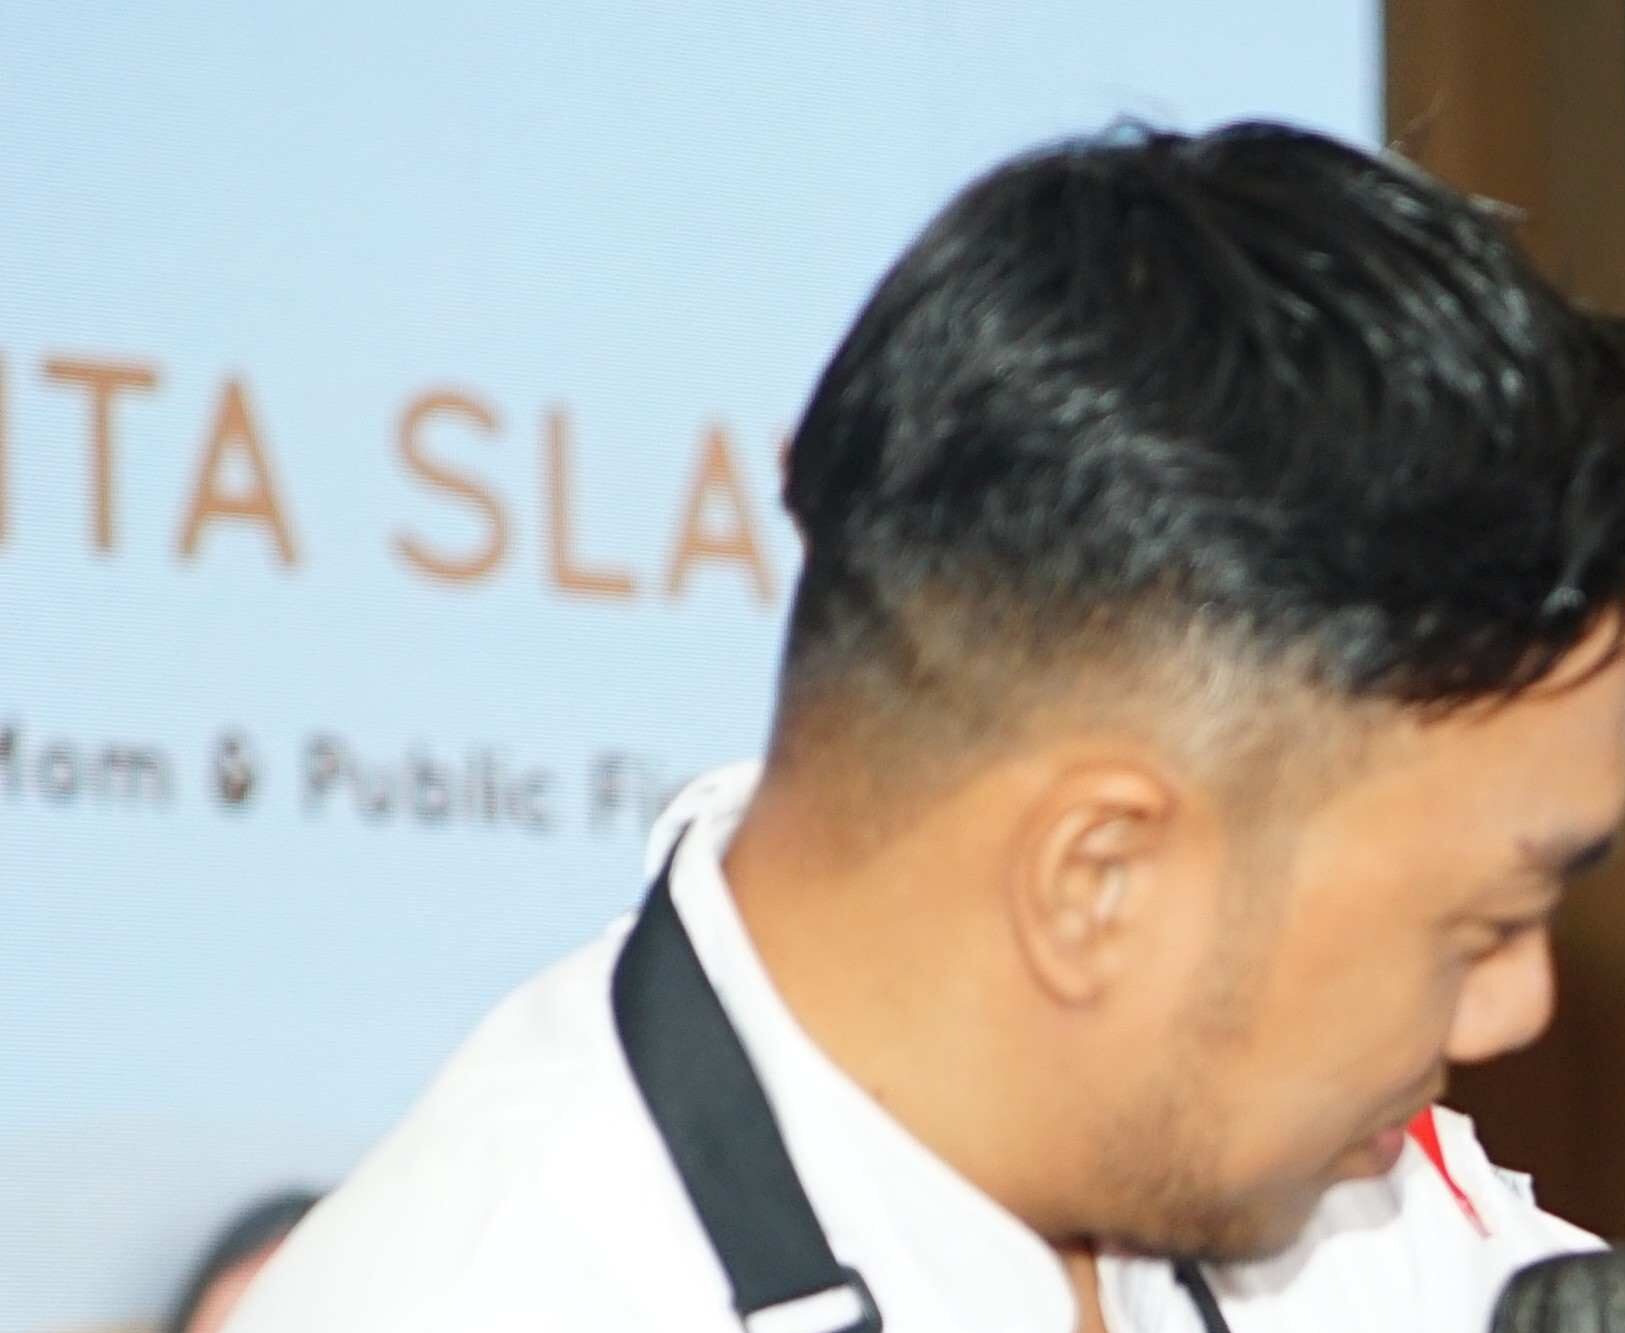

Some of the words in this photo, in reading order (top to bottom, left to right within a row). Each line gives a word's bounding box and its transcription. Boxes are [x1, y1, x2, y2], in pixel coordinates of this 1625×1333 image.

[0, 350, 301, 573] TA
[393, 387, 792, 605] SLA
[302, 733, 550, 834] Public
